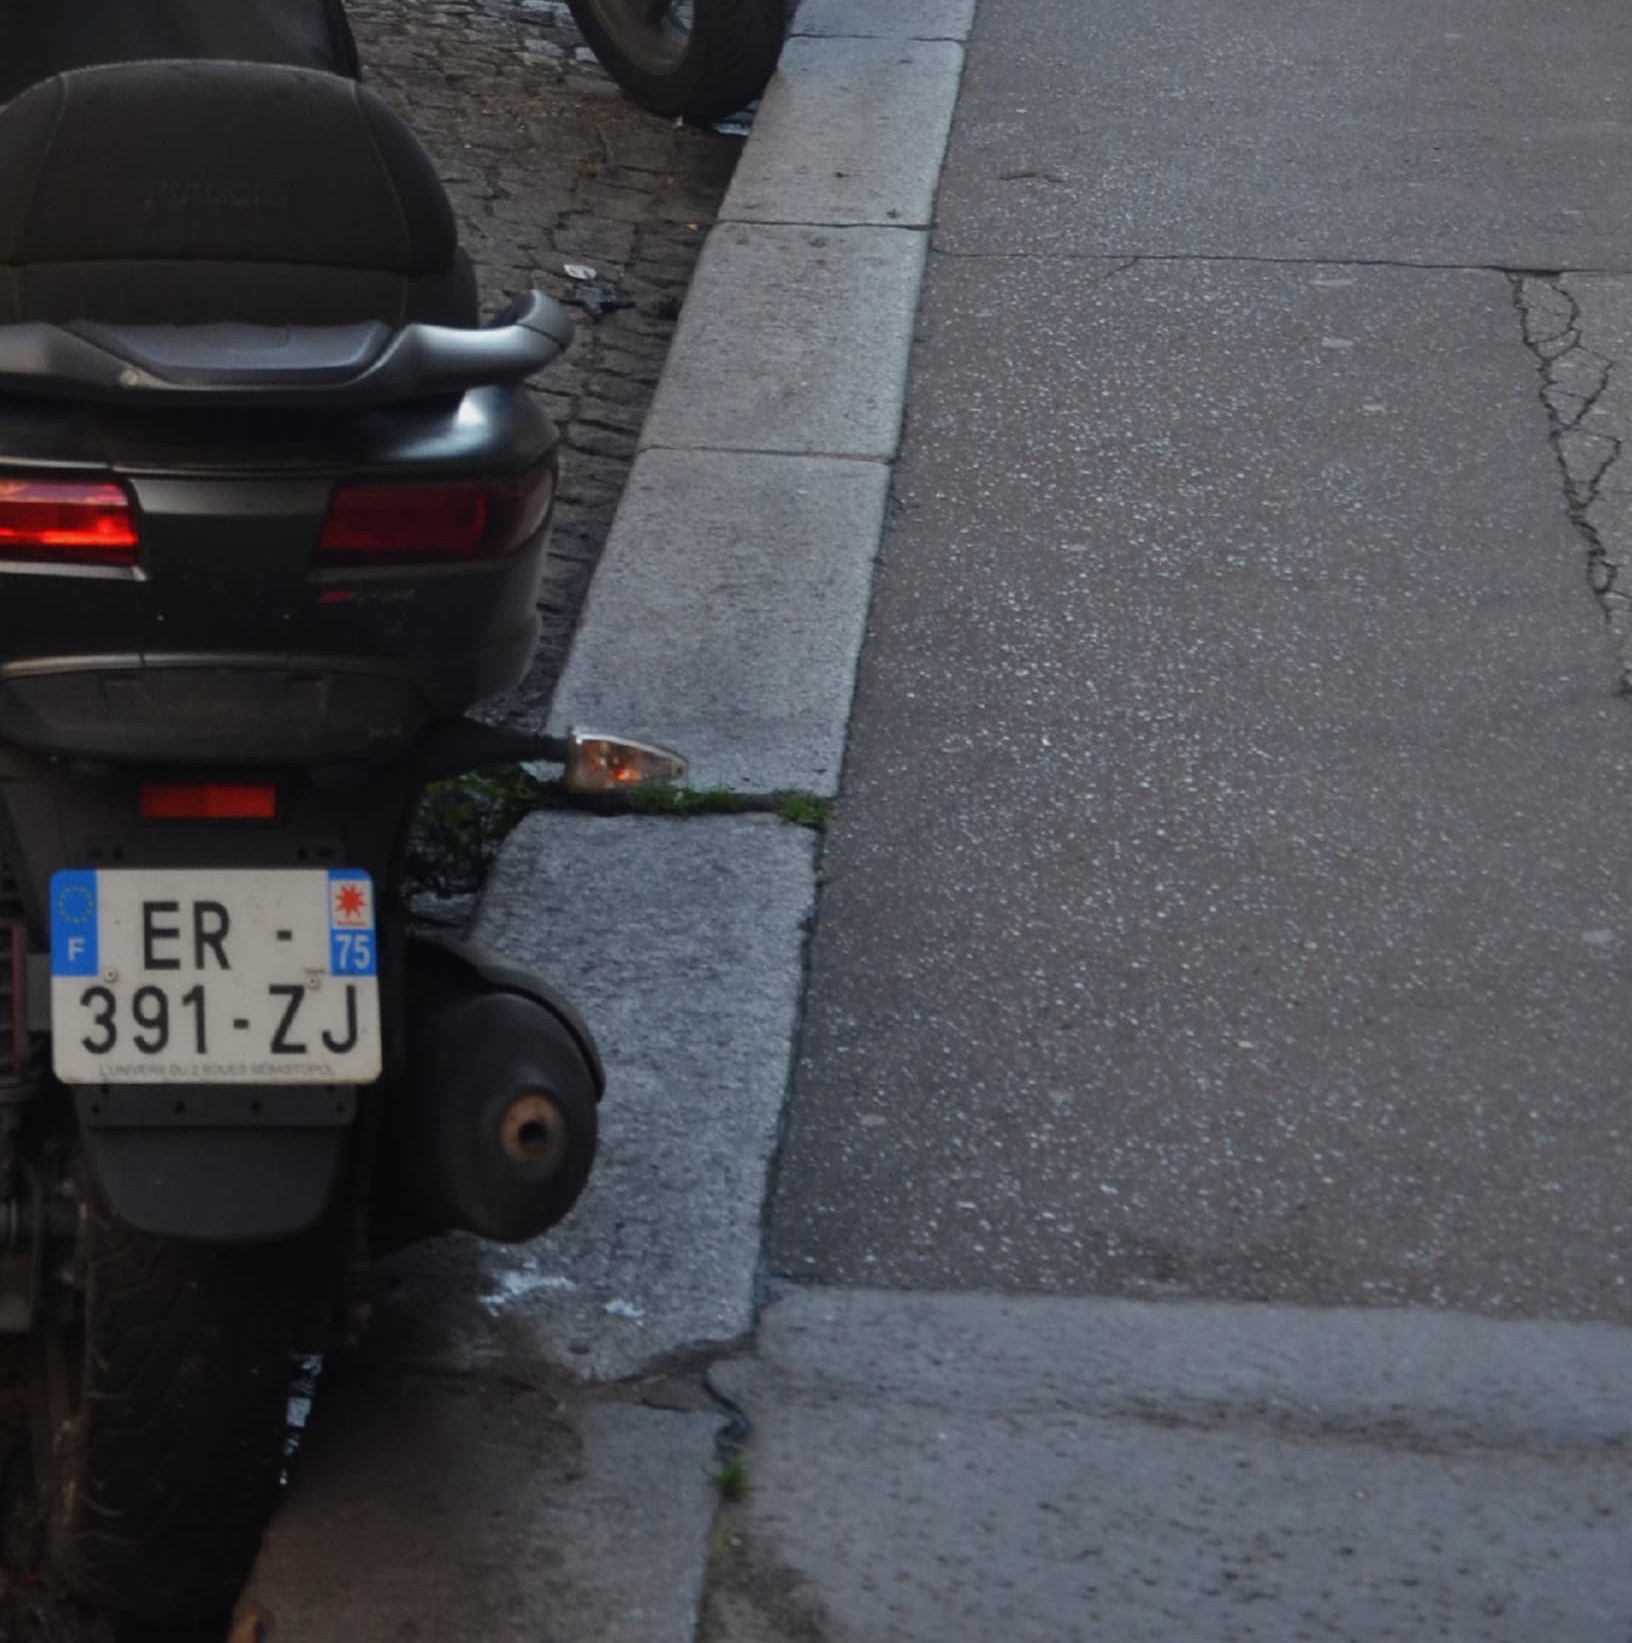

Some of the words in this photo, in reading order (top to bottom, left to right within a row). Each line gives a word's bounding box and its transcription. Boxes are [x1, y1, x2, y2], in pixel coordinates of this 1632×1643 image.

[68, 938, 84, 961] F
[334, 934, 371, 970] 75
[79, 985, 358, 1055] 391-ZJ
